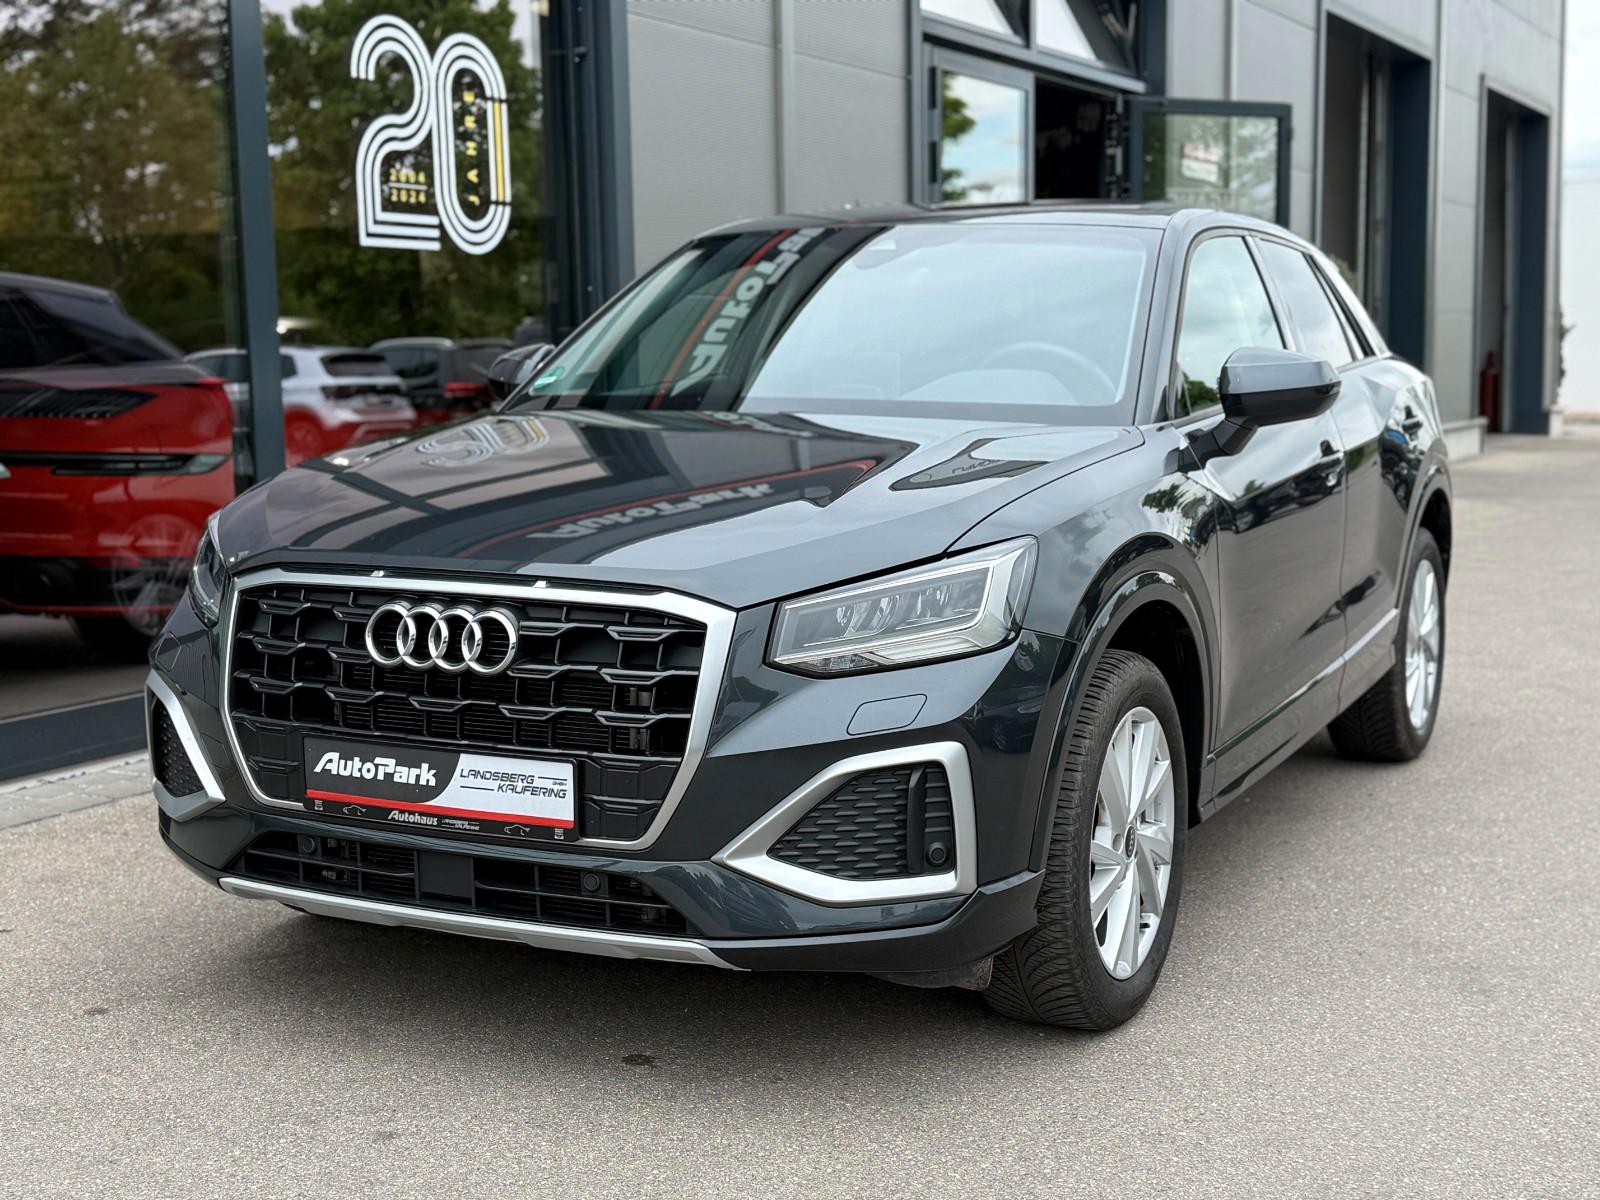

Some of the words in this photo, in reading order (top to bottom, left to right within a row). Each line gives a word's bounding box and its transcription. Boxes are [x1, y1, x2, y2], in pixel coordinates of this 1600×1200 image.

[350, 13, 512, 255] 20
[313, 751, 437, 787] AutoPark
[459, 768, 535, 785] LANDSBERG
[497, 783, 568, 799] KAUFERING
[387, 810, 438, 826] Autohaus
